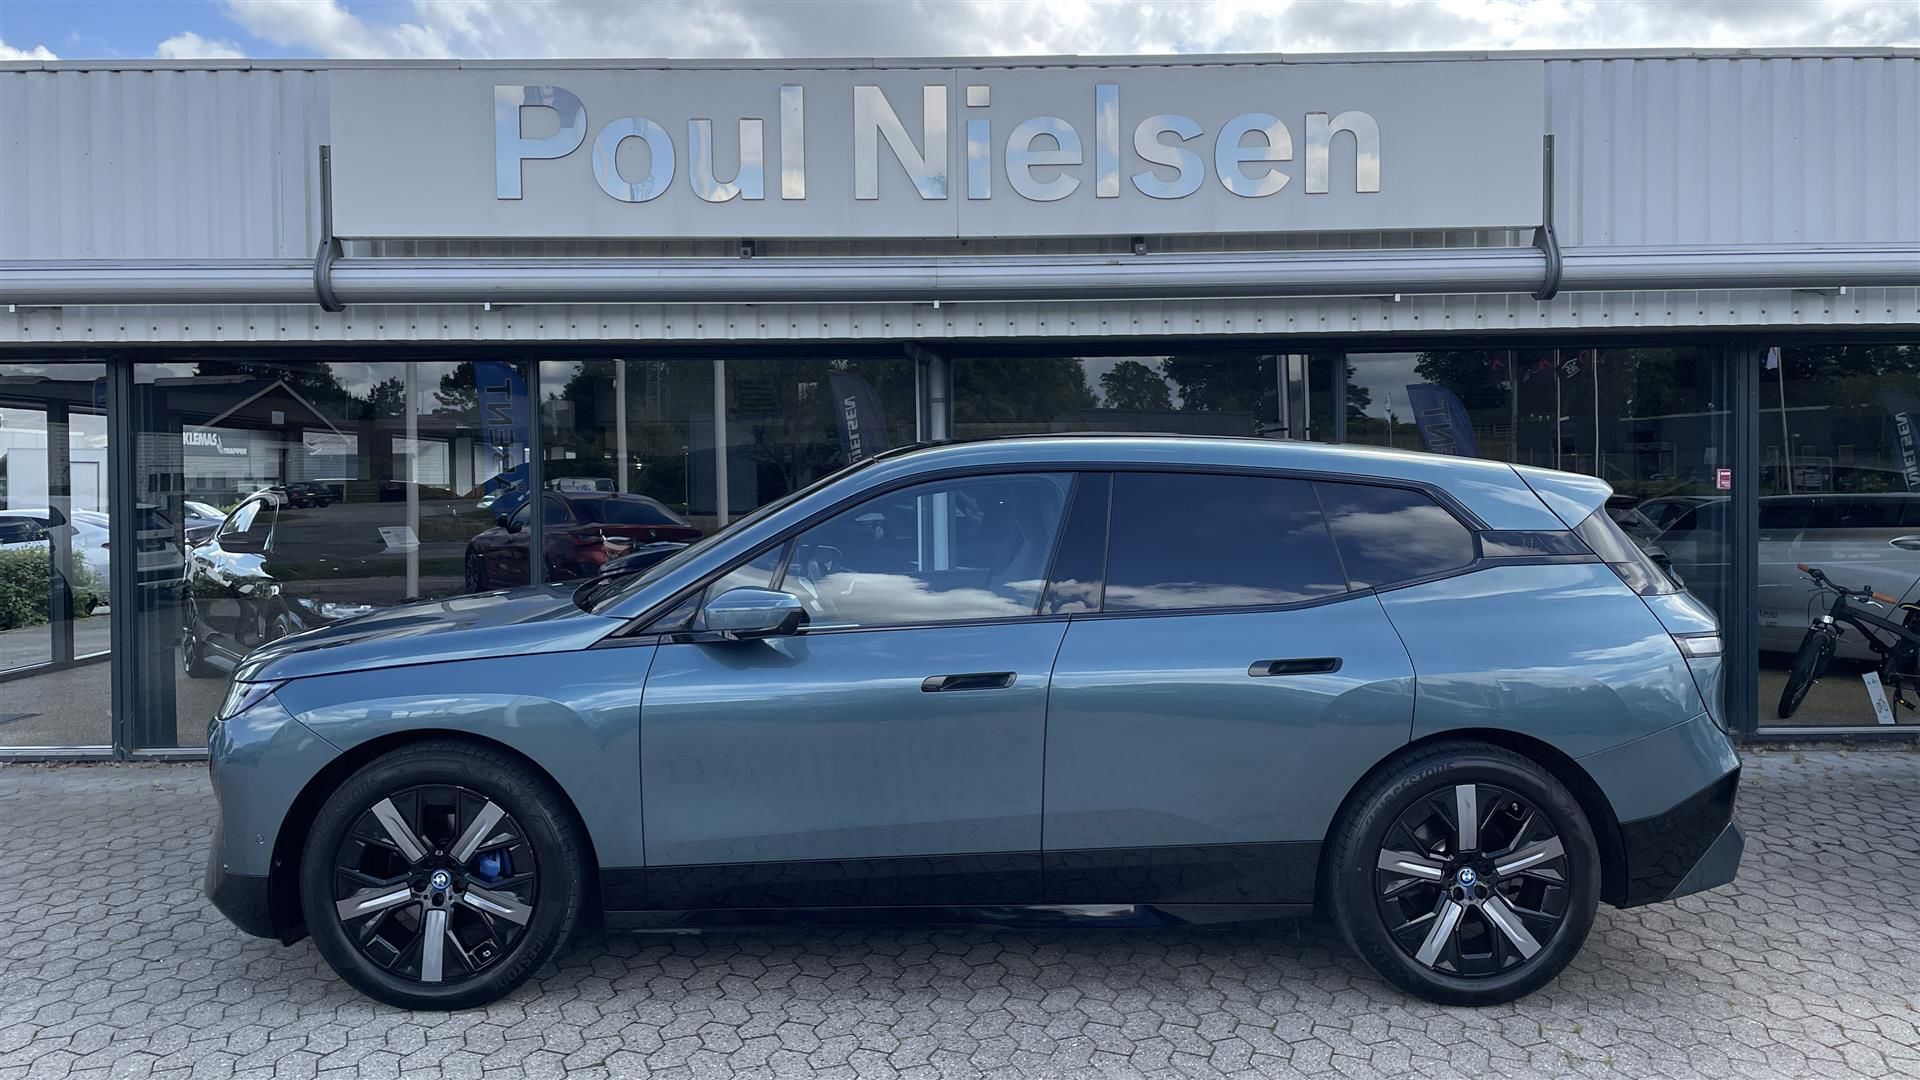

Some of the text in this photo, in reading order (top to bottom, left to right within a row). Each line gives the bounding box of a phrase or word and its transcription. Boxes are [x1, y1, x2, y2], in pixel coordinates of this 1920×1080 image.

[493, 83, 1382, 203] Poul Nielsen
[182, 431, 217, 446] KLEMAS
